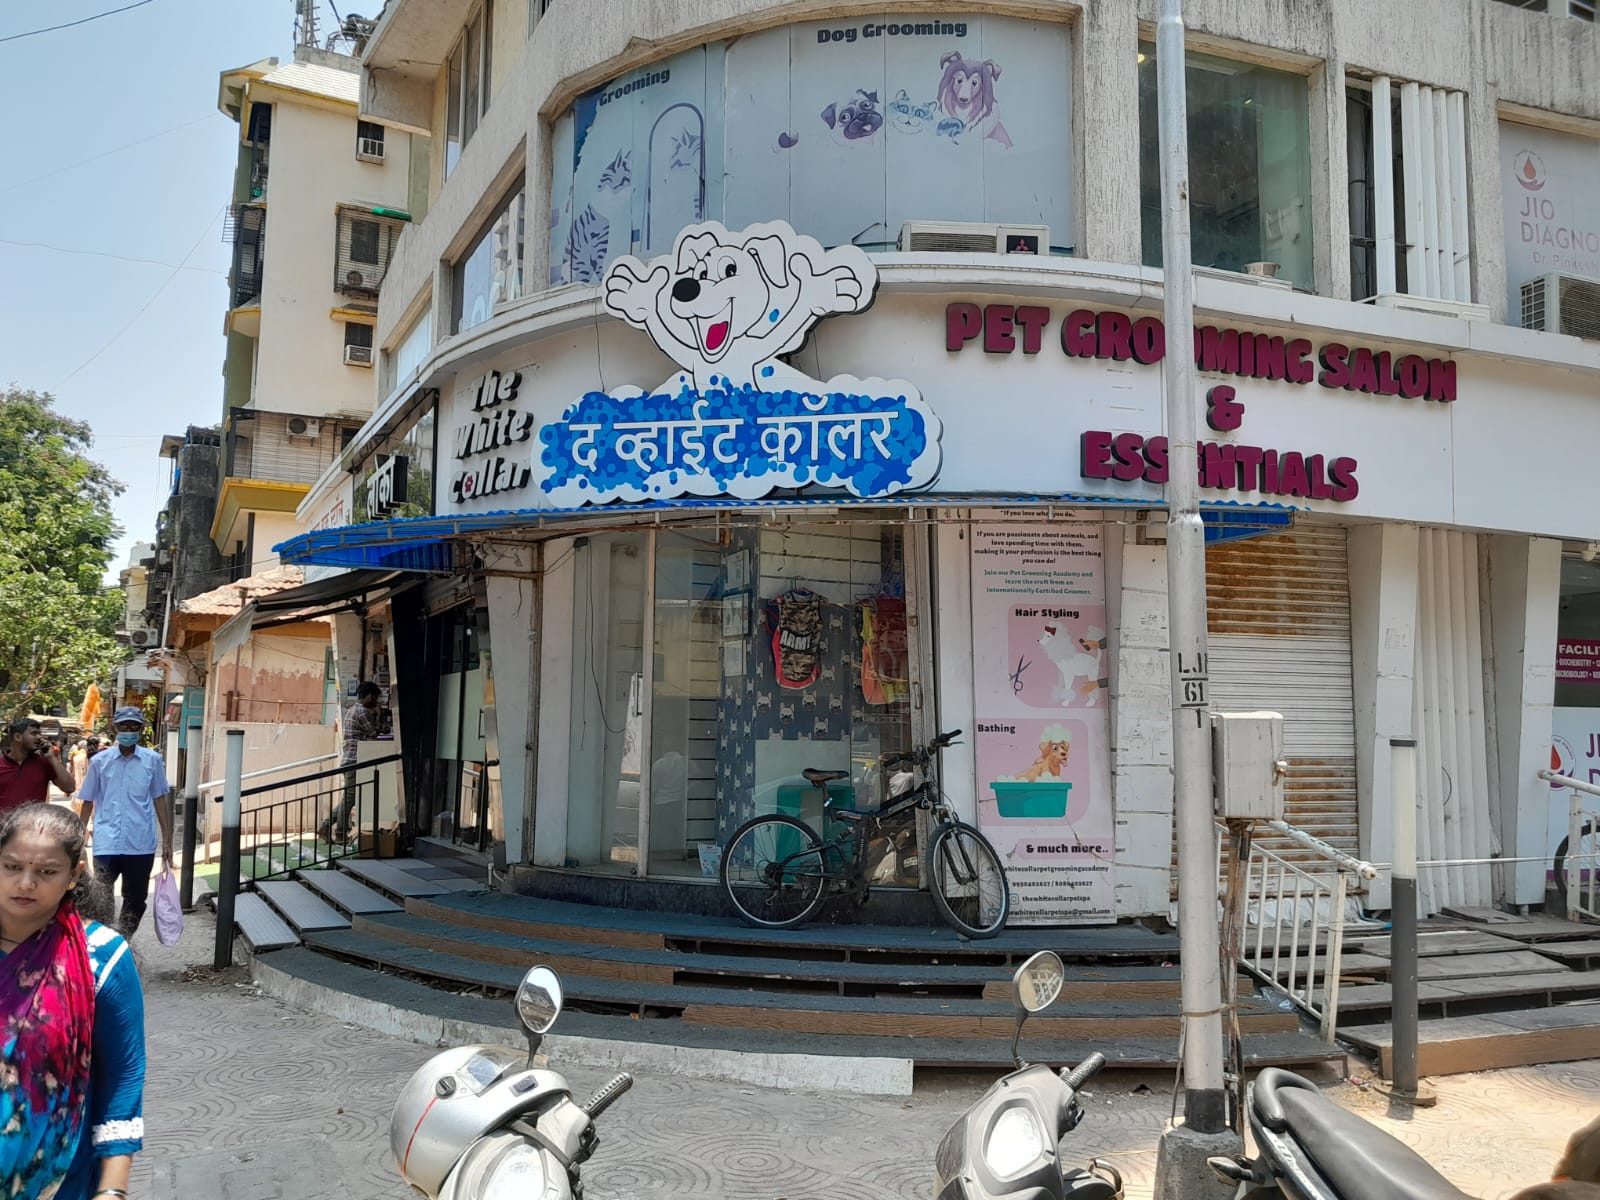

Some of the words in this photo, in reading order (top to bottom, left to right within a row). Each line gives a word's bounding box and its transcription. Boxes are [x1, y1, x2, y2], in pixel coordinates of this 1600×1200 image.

[817, 28, 857, 43] Dog
[862, 20, 968, 38] Grooming
[599, 69, 671, 107] Grooming
[1520, 196, 1555, 220] JIO
[1521, 221, 1600, 253] DIAGNO
[946, 302, 1050, 355] PET
[1060, 308, 1314, 385] GROMING
[1318, 342, 1458, 403] SALON
[471, 369, 522, 412] The
[1206, 384, 1245, 431] &
[455, 408, 534, 459] White
[568, 422, 602, 472] द
[613, 398, 744, 476] व्हाईट
[756, 395, 899, 463] कॉलर
[1015, 608, 1039, 617] Hair
[1041, 608, 1080, 619] Styling
[1558, 644, 1600, 656] FACILI
[977, 724, 1016, 734] Bathing
[1026, 844, 1035, 853] &
[1037, 843, 1069, 853] much
